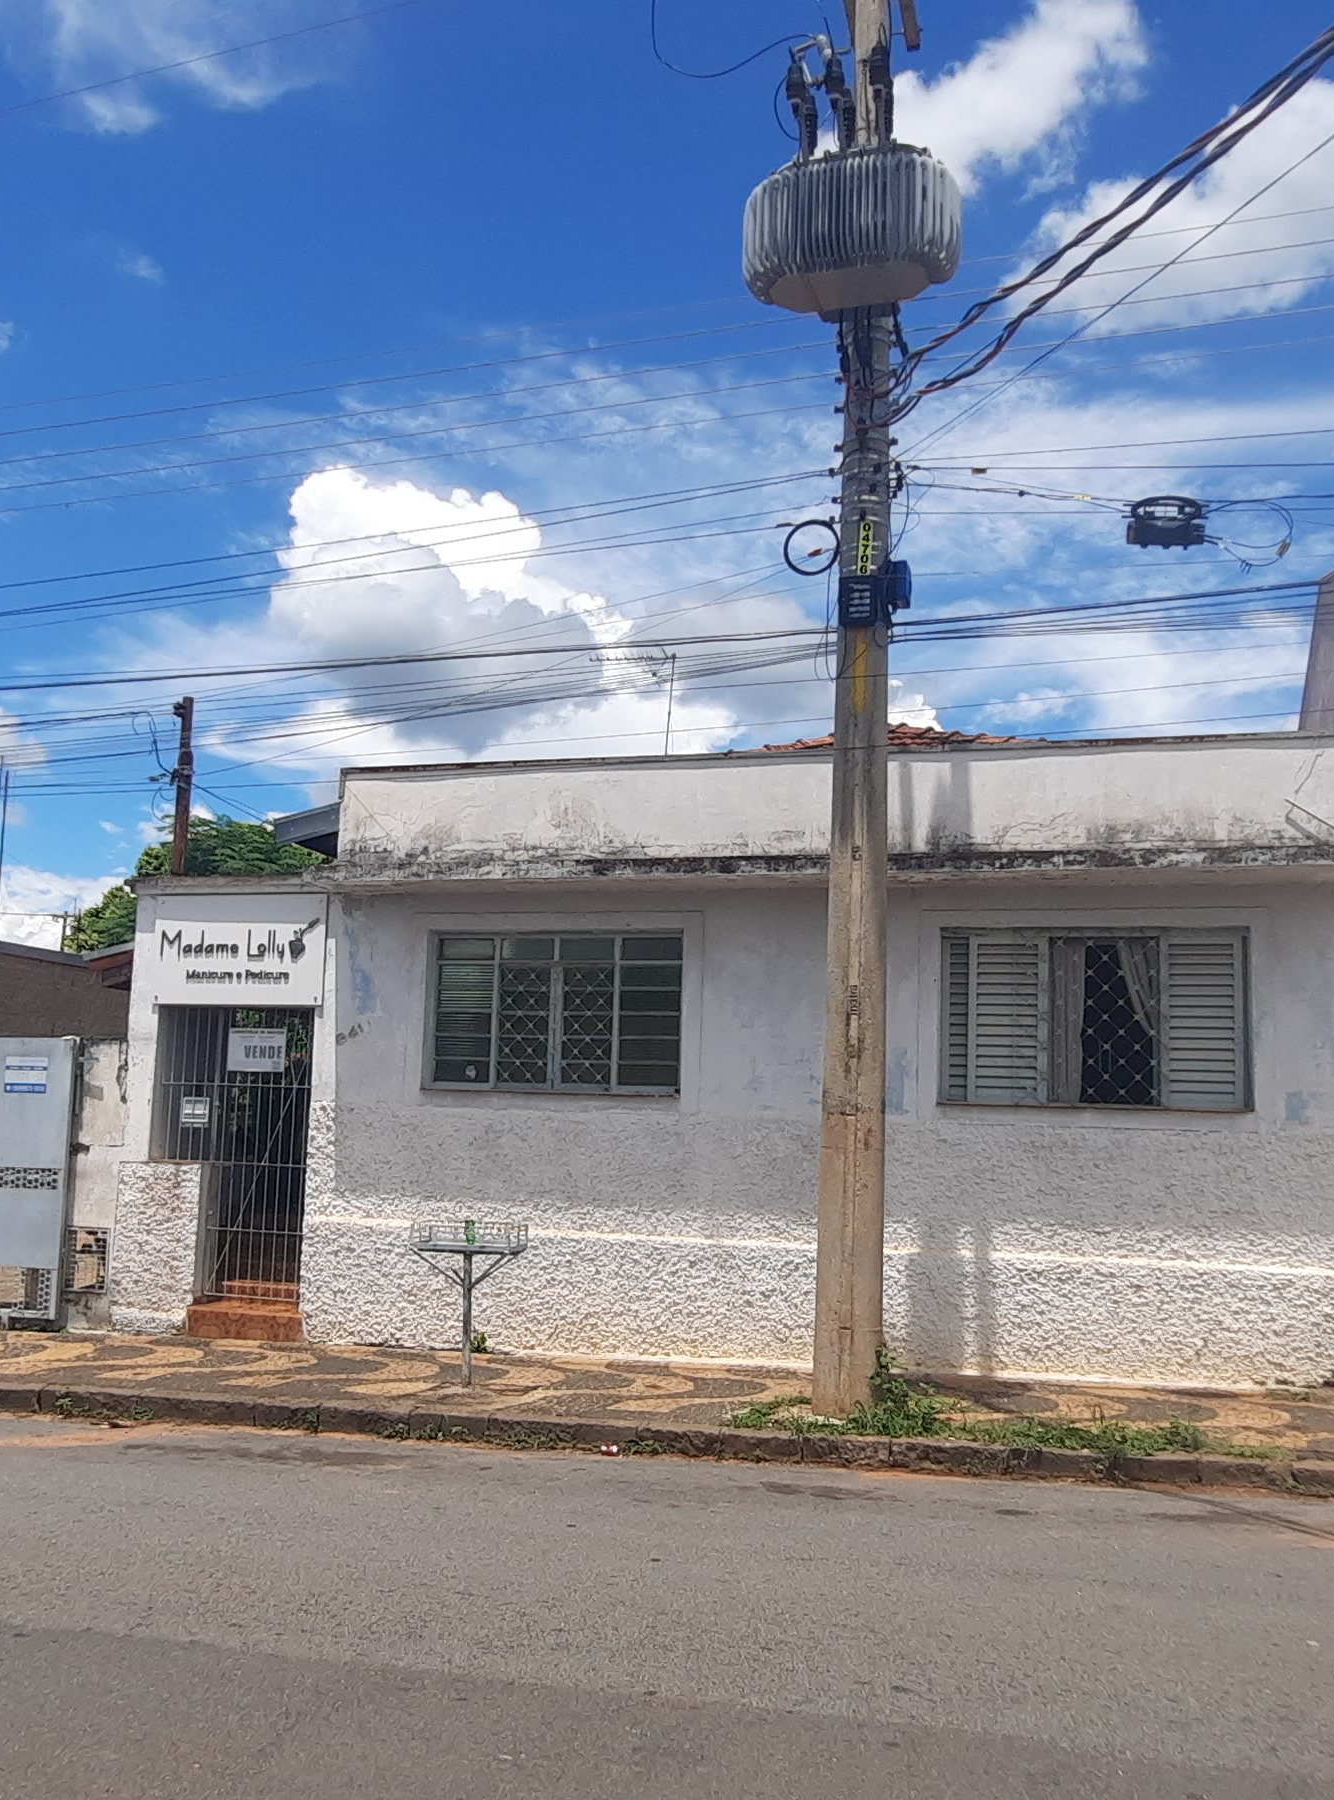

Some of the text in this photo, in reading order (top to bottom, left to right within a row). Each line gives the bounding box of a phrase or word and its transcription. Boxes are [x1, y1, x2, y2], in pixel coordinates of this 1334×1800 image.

[160, 929, 285, 960] Madame Lolly
[185, 969, 234, 981] Manicure
[245, 969, 290, 981] Pedicure
[244, 1045, 283, 1059] VENDE
